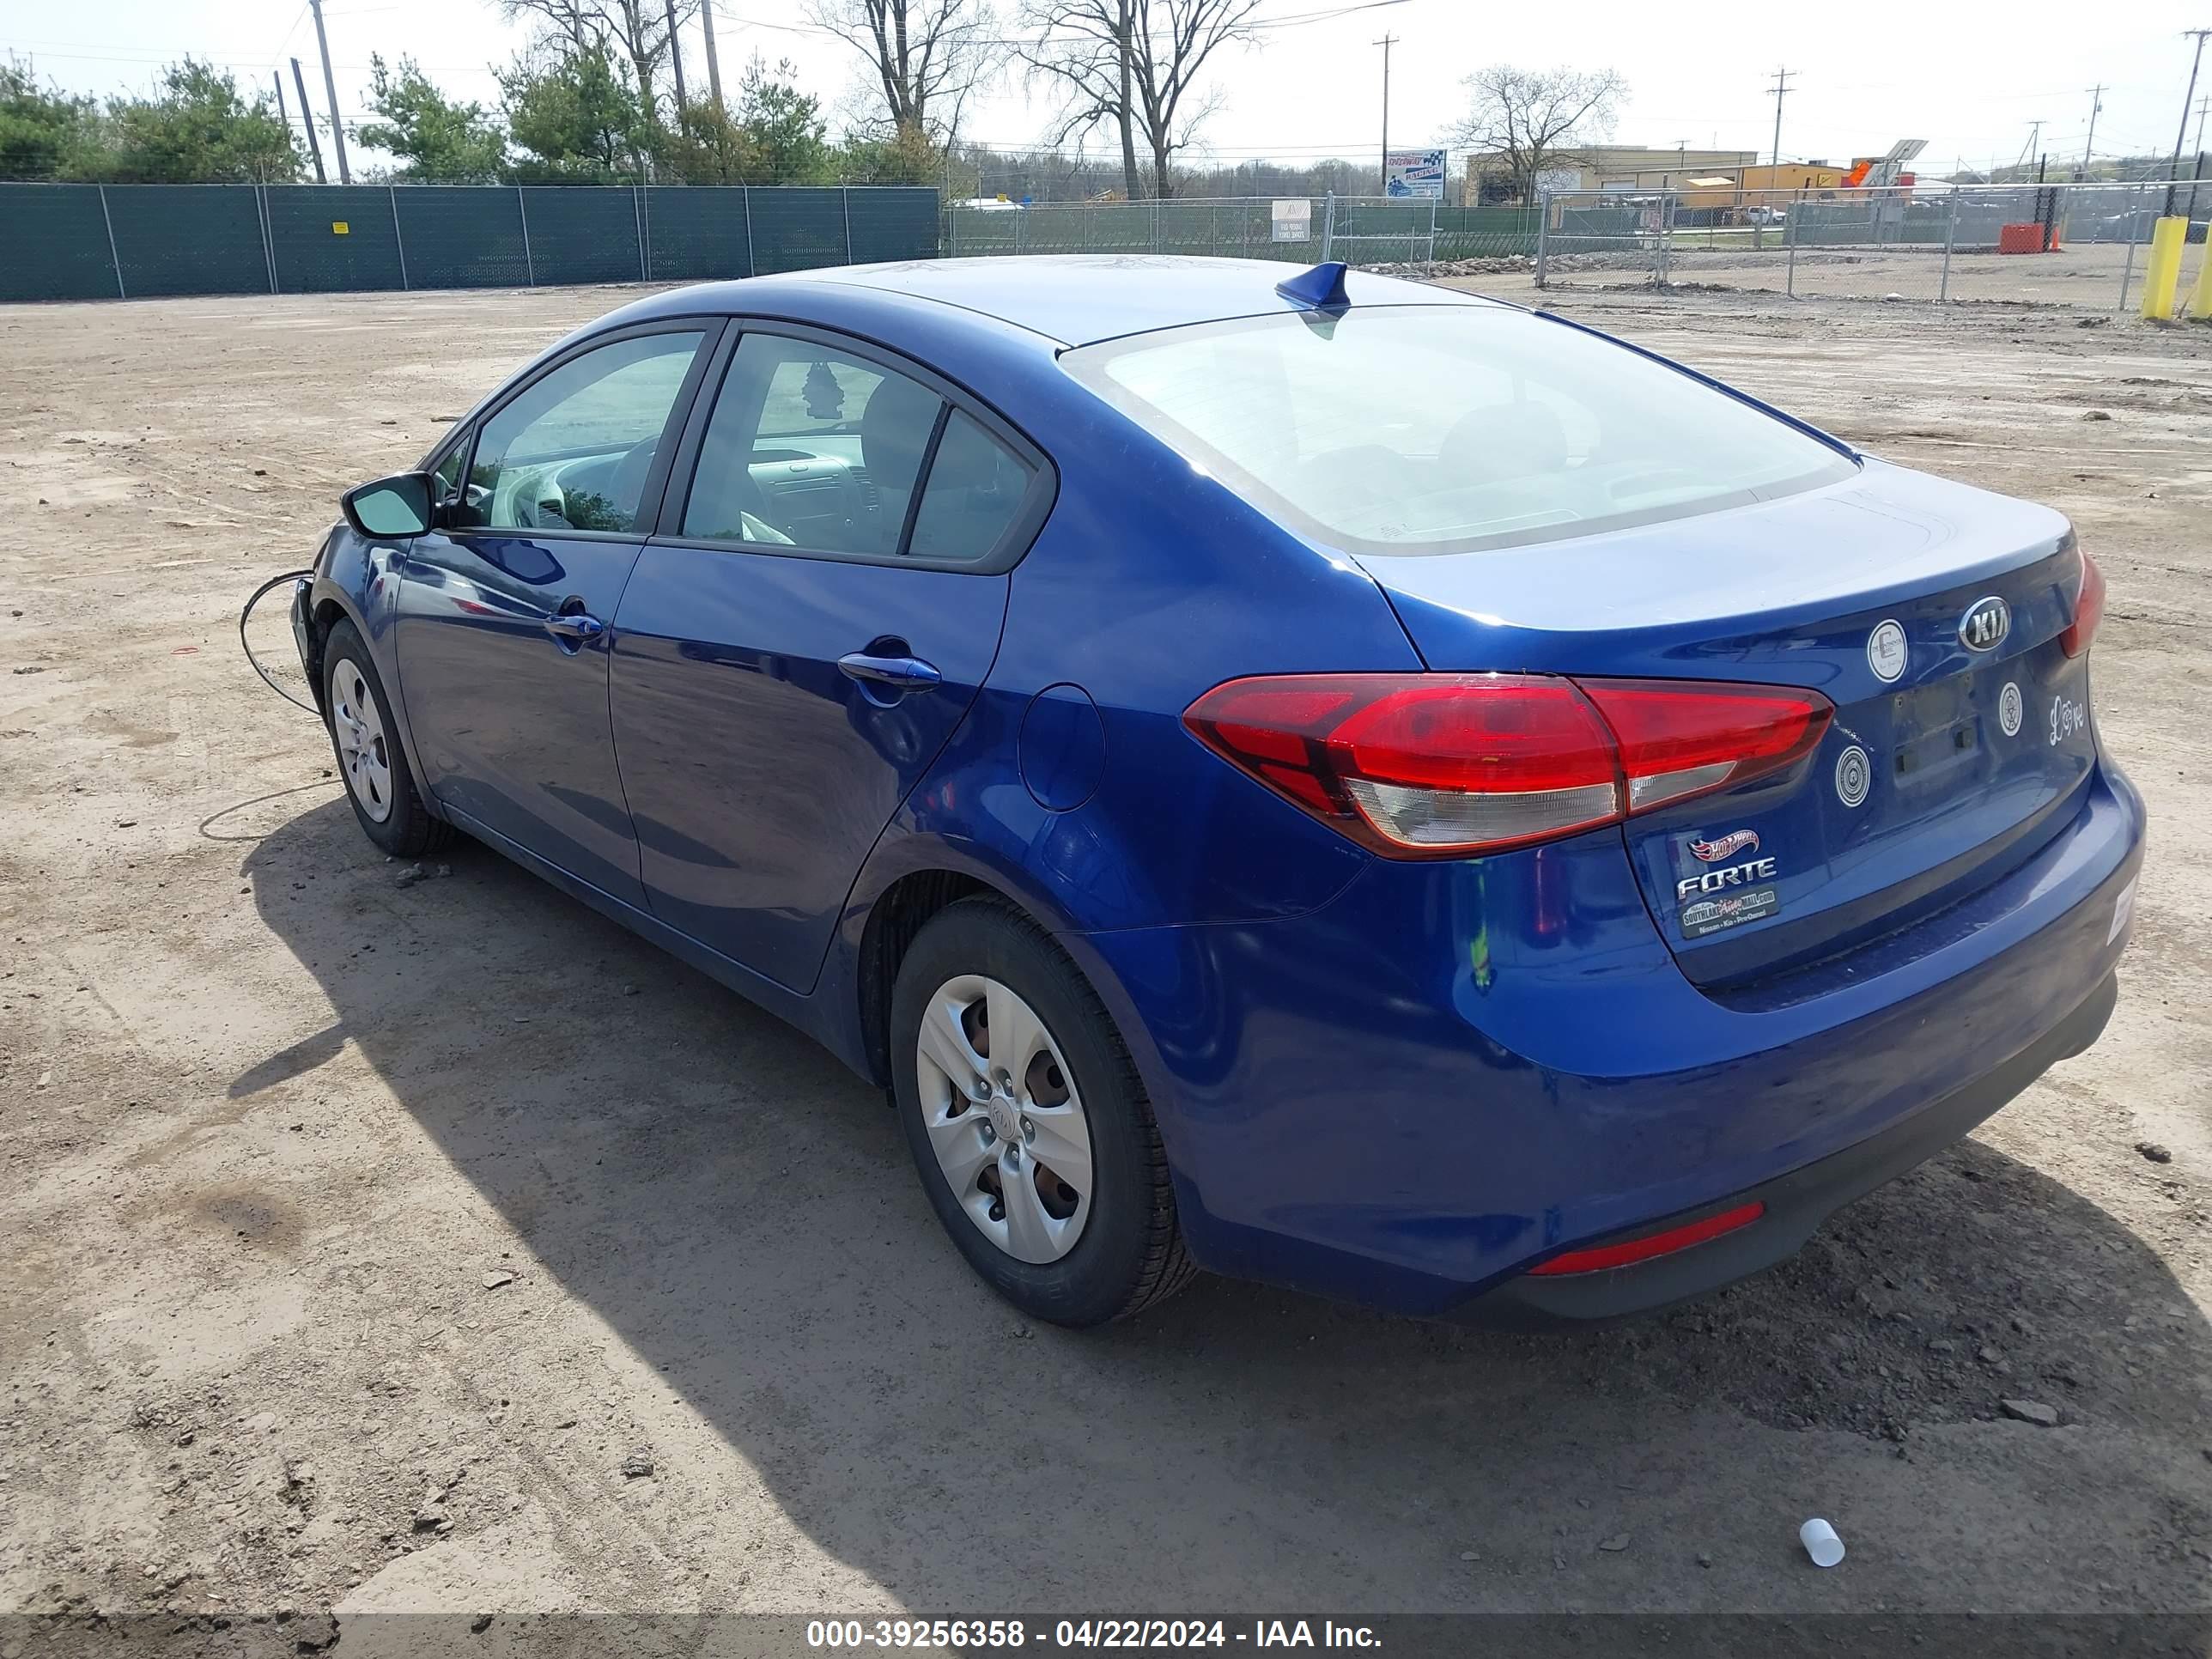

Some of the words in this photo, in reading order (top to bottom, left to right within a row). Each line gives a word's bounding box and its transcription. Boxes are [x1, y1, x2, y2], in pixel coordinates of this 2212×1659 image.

[1388, 156, 1422, 166] SPEEDWAY
[1405, 167, 1439, 180] RACING
[1972, 606, 2008, 644] KIA
[1677, 857, 1778, 900] FORTE
[1698, 923, 1722, 934] Nissan
[1723, 918, 1734, 927] Kia
